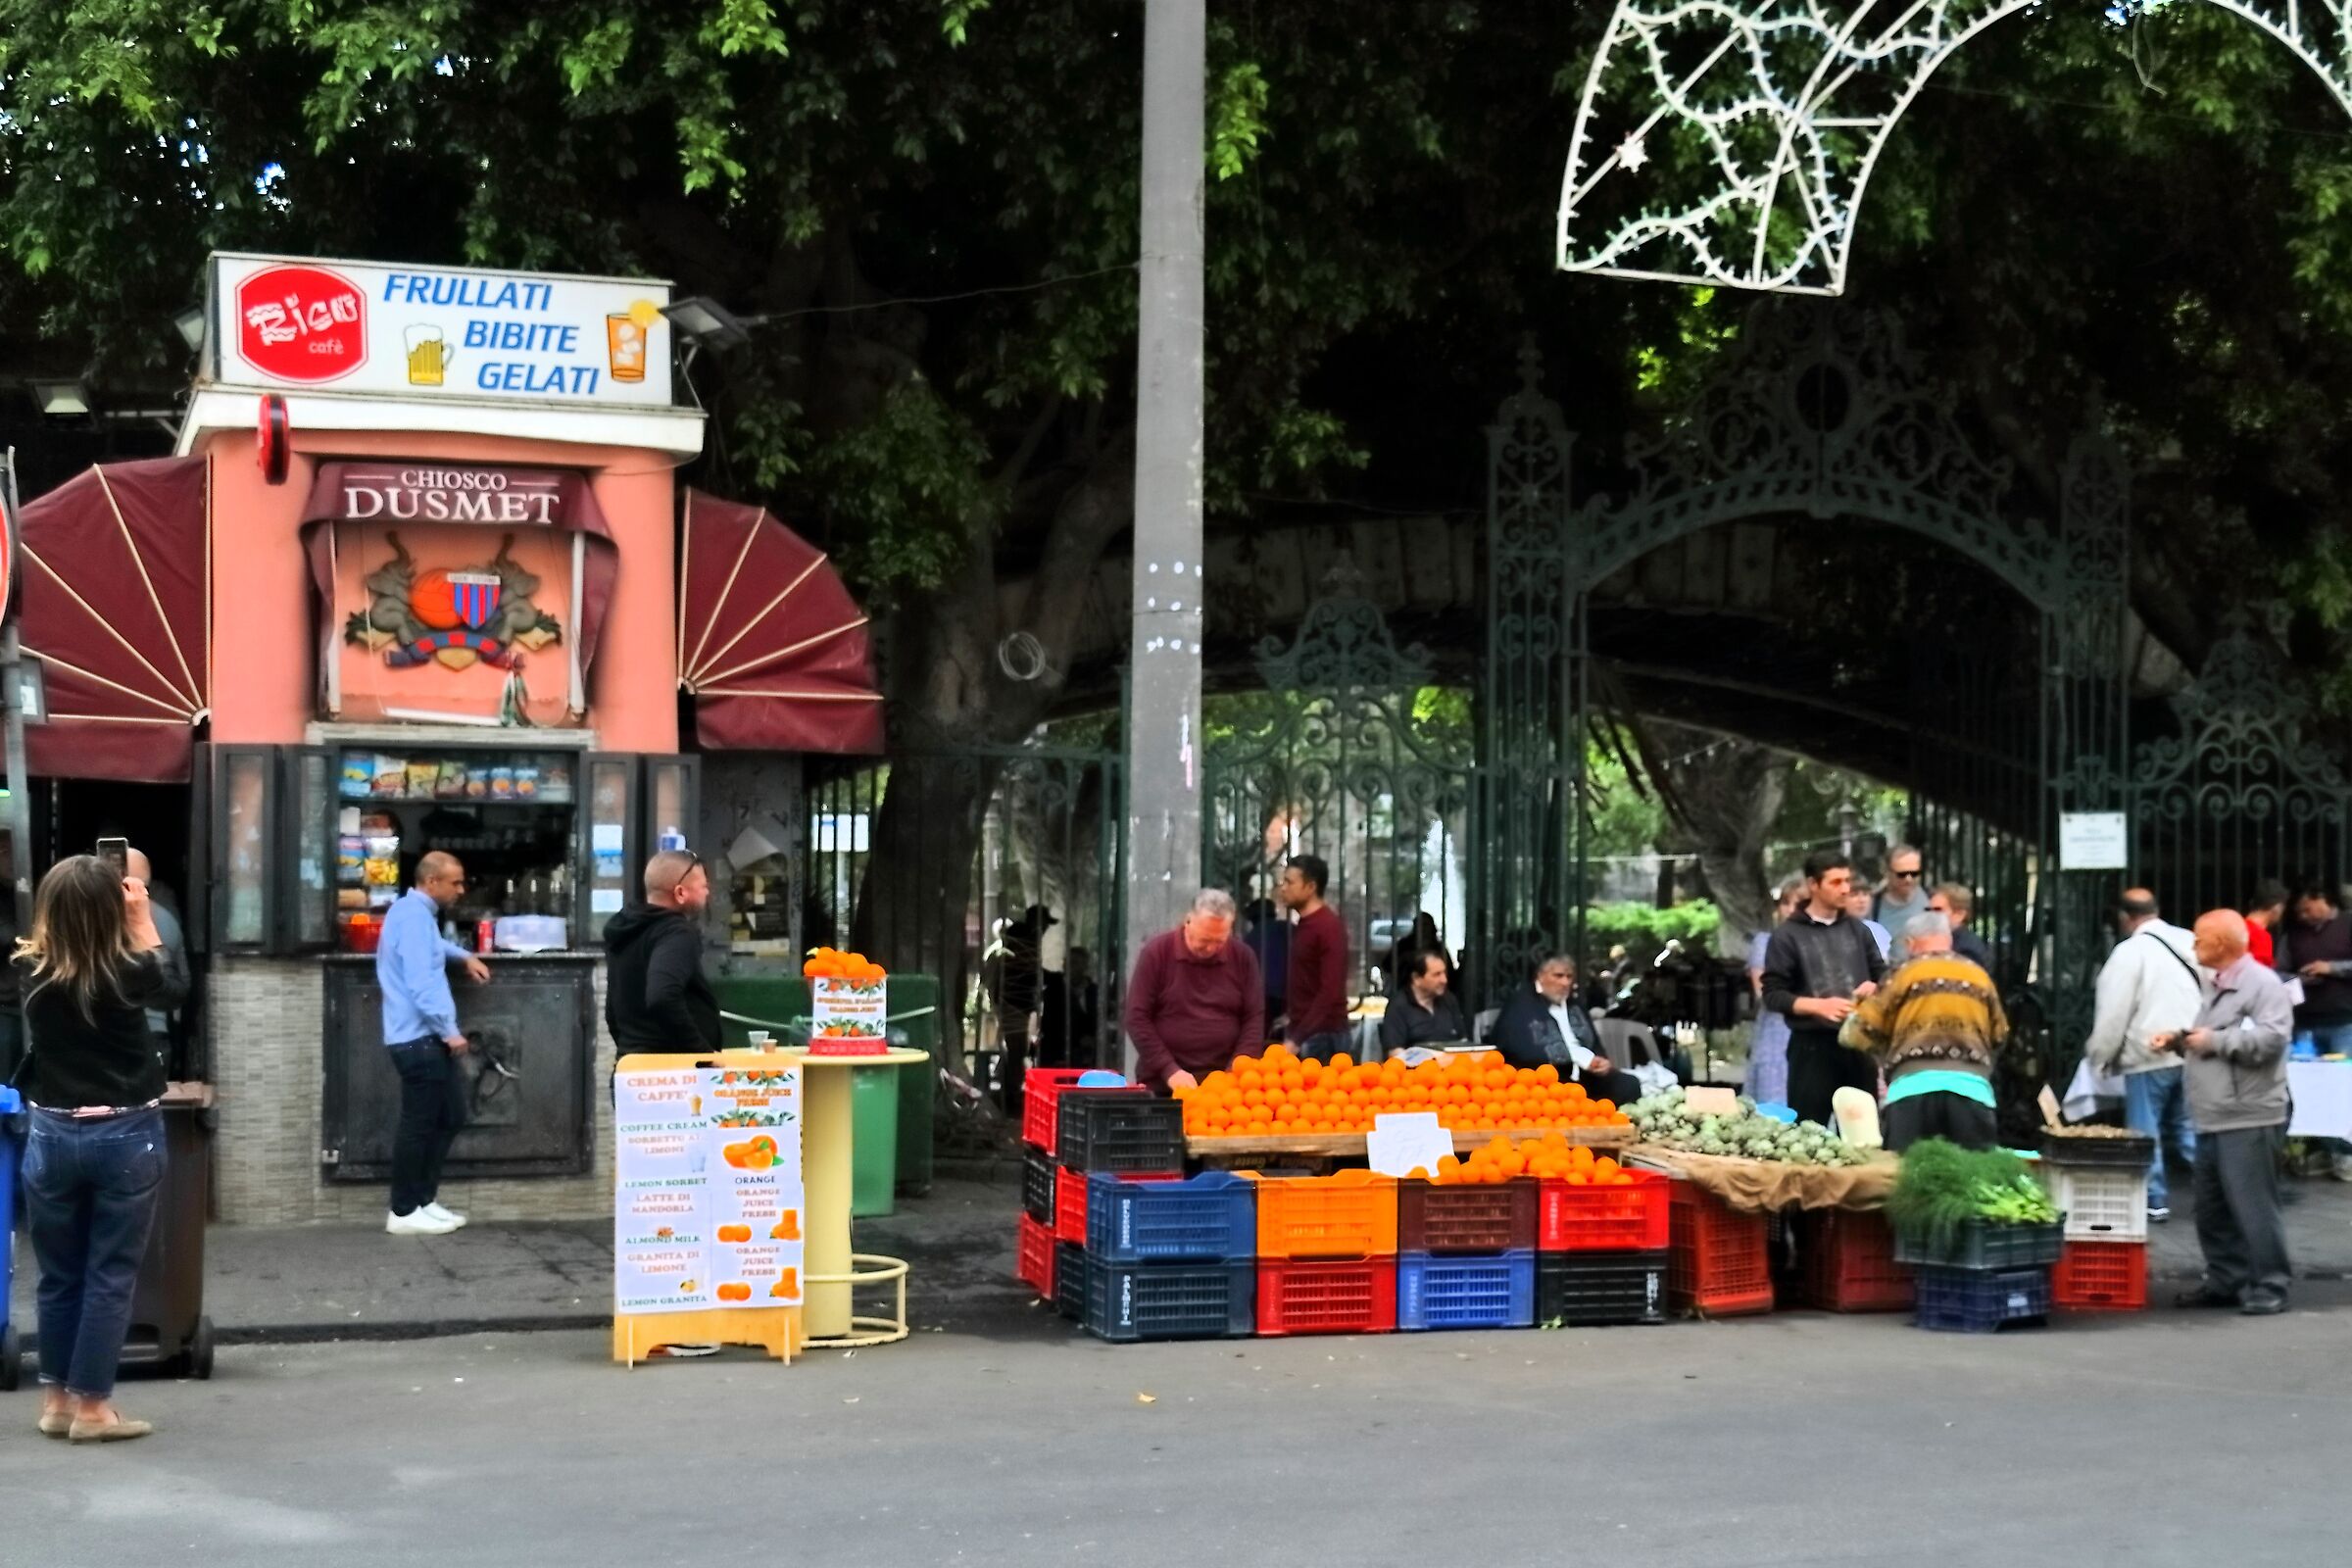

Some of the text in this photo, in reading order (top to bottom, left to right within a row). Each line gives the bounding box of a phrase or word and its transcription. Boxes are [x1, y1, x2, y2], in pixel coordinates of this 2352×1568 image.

[383, 273, 552, 312] FRULLATI
[246, 292, 359, 346] Rico
[464, 319, 580, 354] BIBITE
[477, 362, 601, 395] GELATI
[400, 469, 508, 491] CHIOSCO
[344, 487, 561, 524] DUSMET
[627, 1075, 697, 1087] CREMA DI
[620, 1121, 708, 1133] COFFEE CREAM
[628, 1135, 685, 1145] SORBETTO
[625, 1177, 708, 1189] LEMON SORBET
[636, 1193, 691, 1201] LATTE DI
[631, 1204, 694, 1213] MANDORLA
[742, 1209, 776, 1218] FRESH
[625, 1236, 672, 1245] ALMOND
[627, 1250, 700, 1261] GRANITA DI
[642, 1263, 687, 1273] LIMONE
[742, 1268, 776, 1277] FRESH
[621, 1295, 708, 1307] LEMON GRANITA
